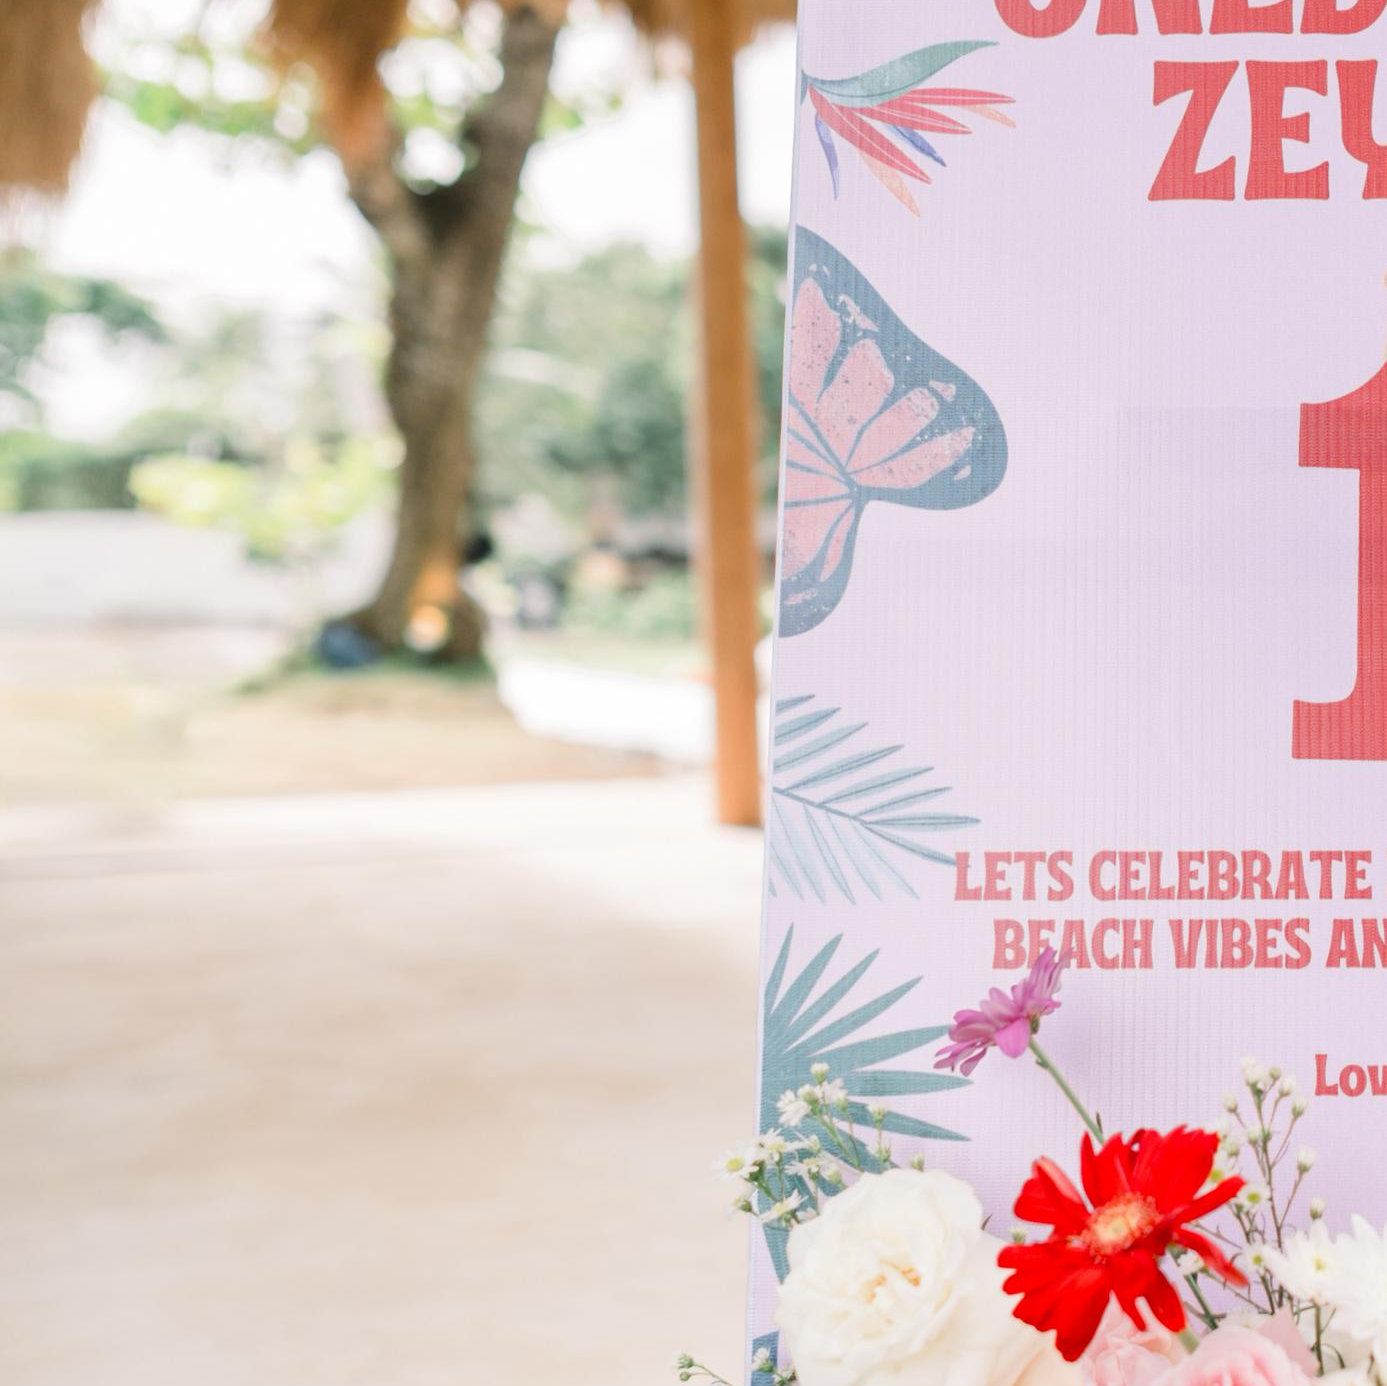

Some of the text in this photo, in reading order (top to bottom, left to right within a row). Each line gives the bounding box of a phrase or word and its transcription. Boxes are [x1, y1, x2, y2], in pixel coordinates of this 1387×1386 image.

[955, 851, 1074, 901] LETS
[1089, 849, 1373, 901] CELEBRATE
[992, 918, 1153, 970] BEACH
[1168, 917, 1312, 970] VIBES
